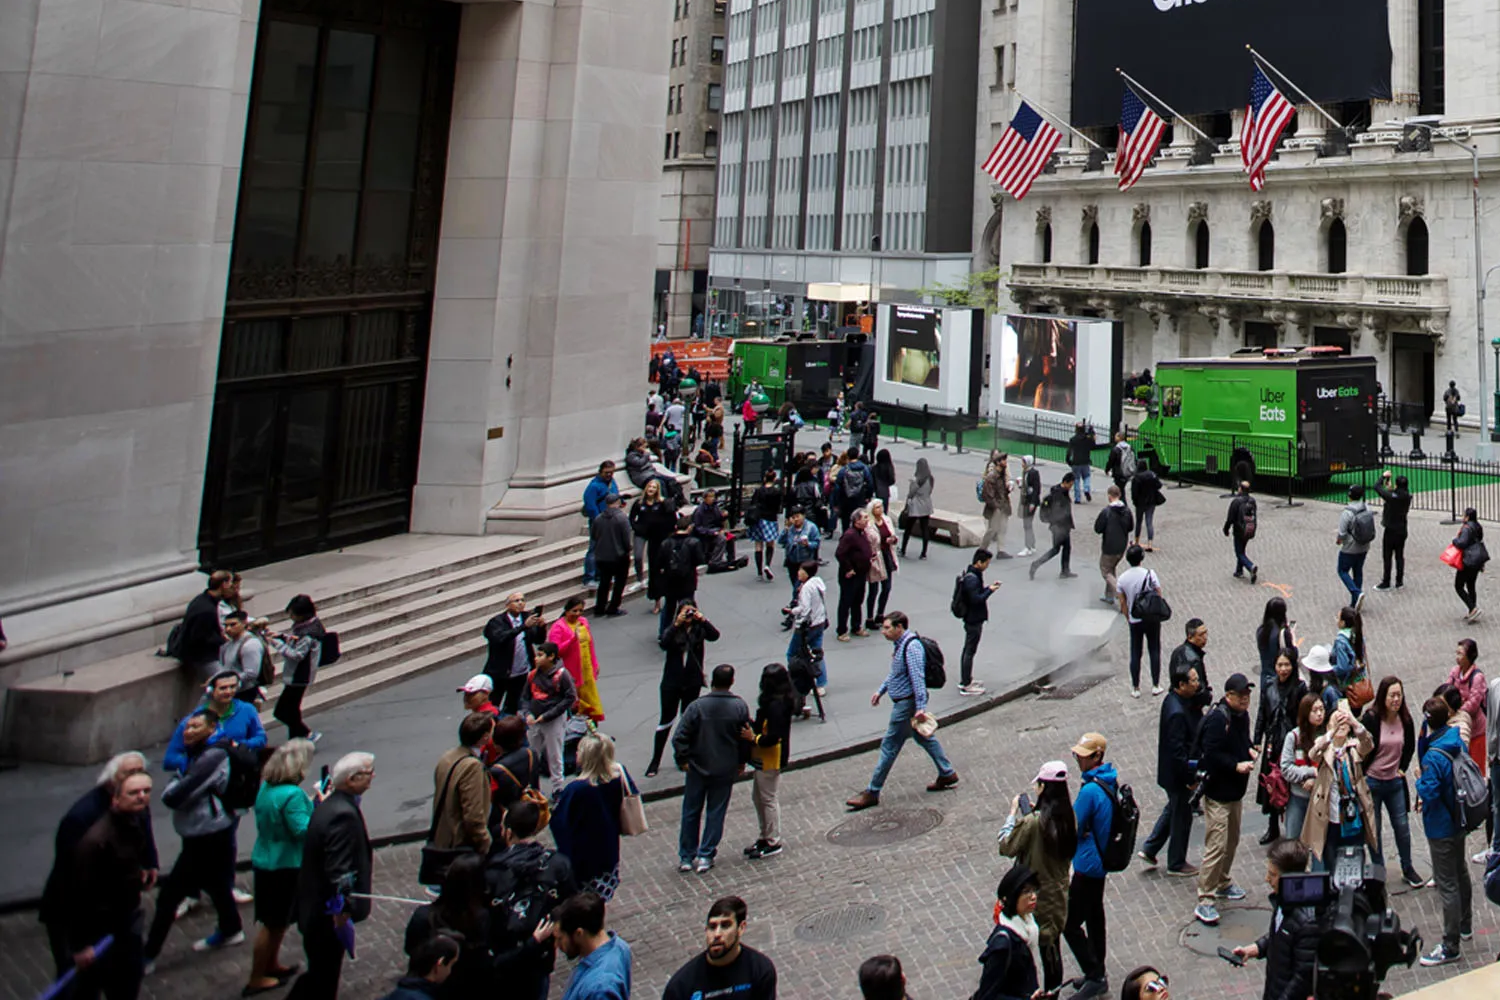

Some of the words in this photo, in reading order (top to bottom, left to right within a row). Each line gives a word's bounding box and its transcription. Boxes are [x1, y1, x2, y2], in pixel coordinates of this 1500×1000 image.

[1260, 387, 1286, 403] Uber
[1316, 387, 1338, 399] Uber
[1338, 386, 1359, 398] Eats
[1260, 405, 1286, 422] Eats
